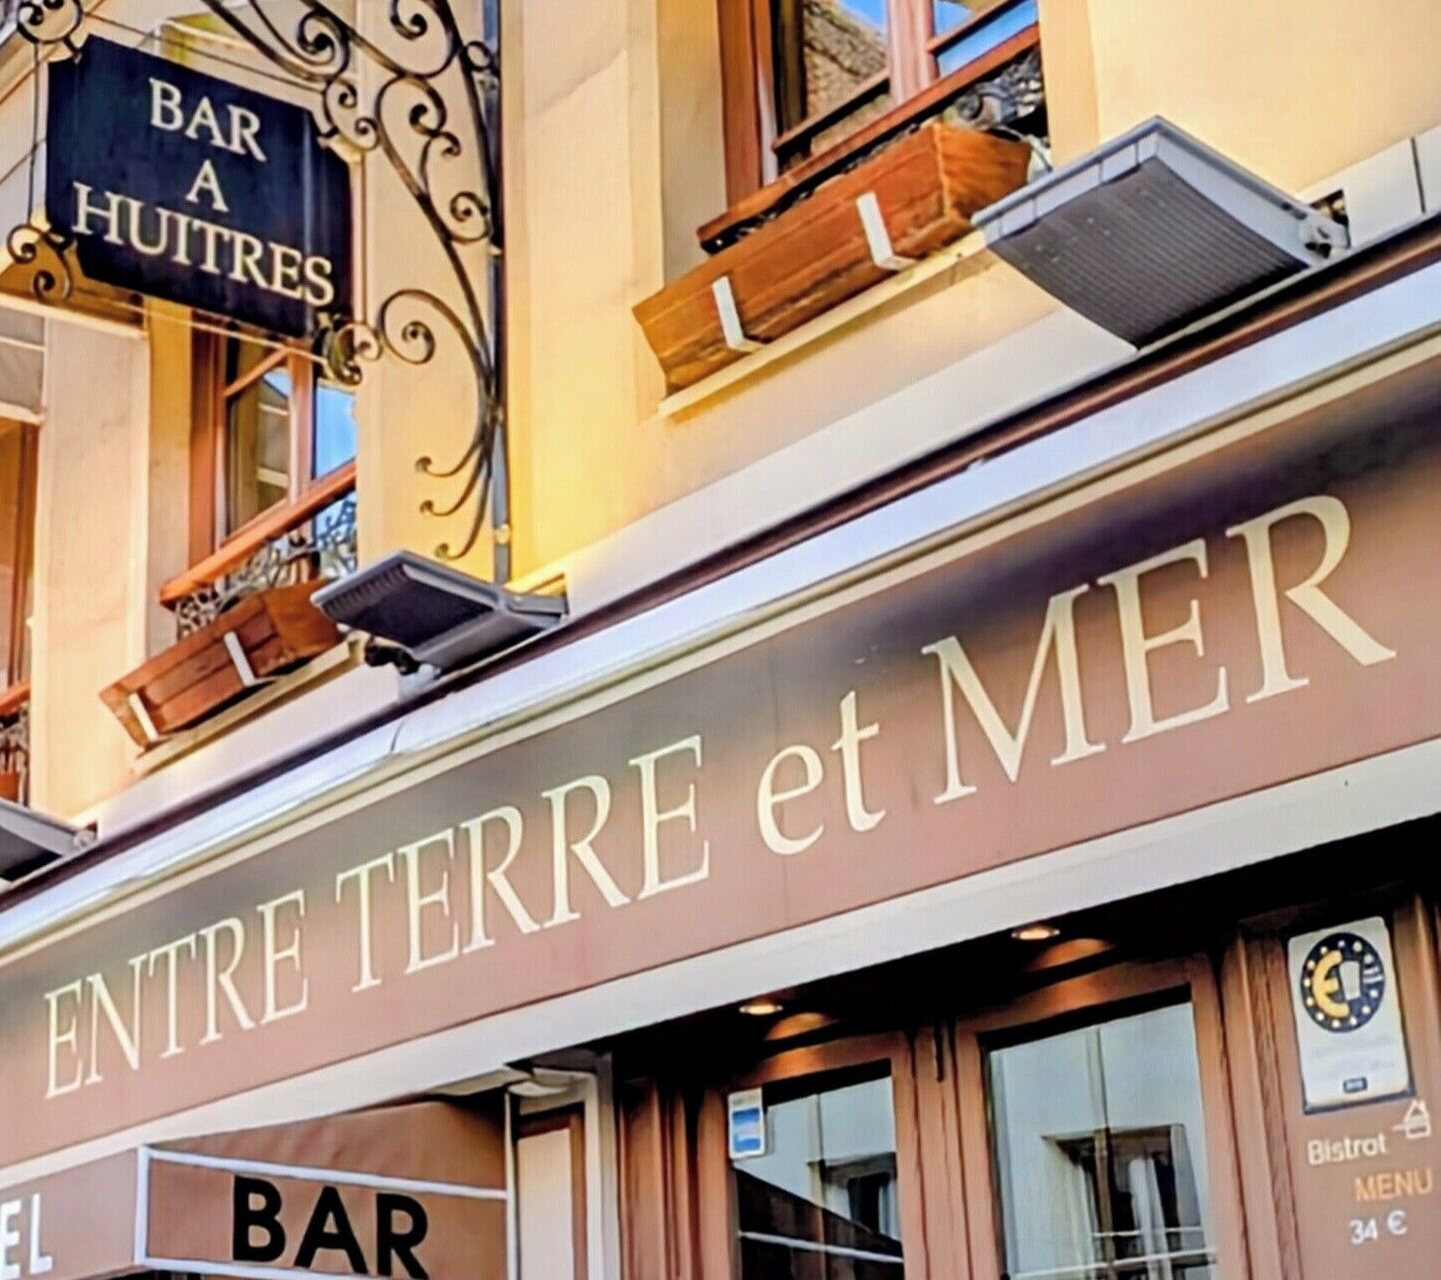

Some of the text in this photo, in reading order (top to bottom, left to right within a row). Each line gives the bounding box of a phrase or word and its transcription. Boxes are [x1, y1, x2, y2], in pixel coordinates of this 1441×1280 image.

[149, 76, 267, 162] BAR
[185, 159, 229, 212] A
[72, 181, 335, 307] HUITRES
[44, 495, 1397, 1099] ENTRE TERRE et MER
[1308, 1133, 1386, 1165] Bistrot
[1355, 1169, 1433, 1202] MENU
[1350, 1209, 1407, 1245] 34 €
